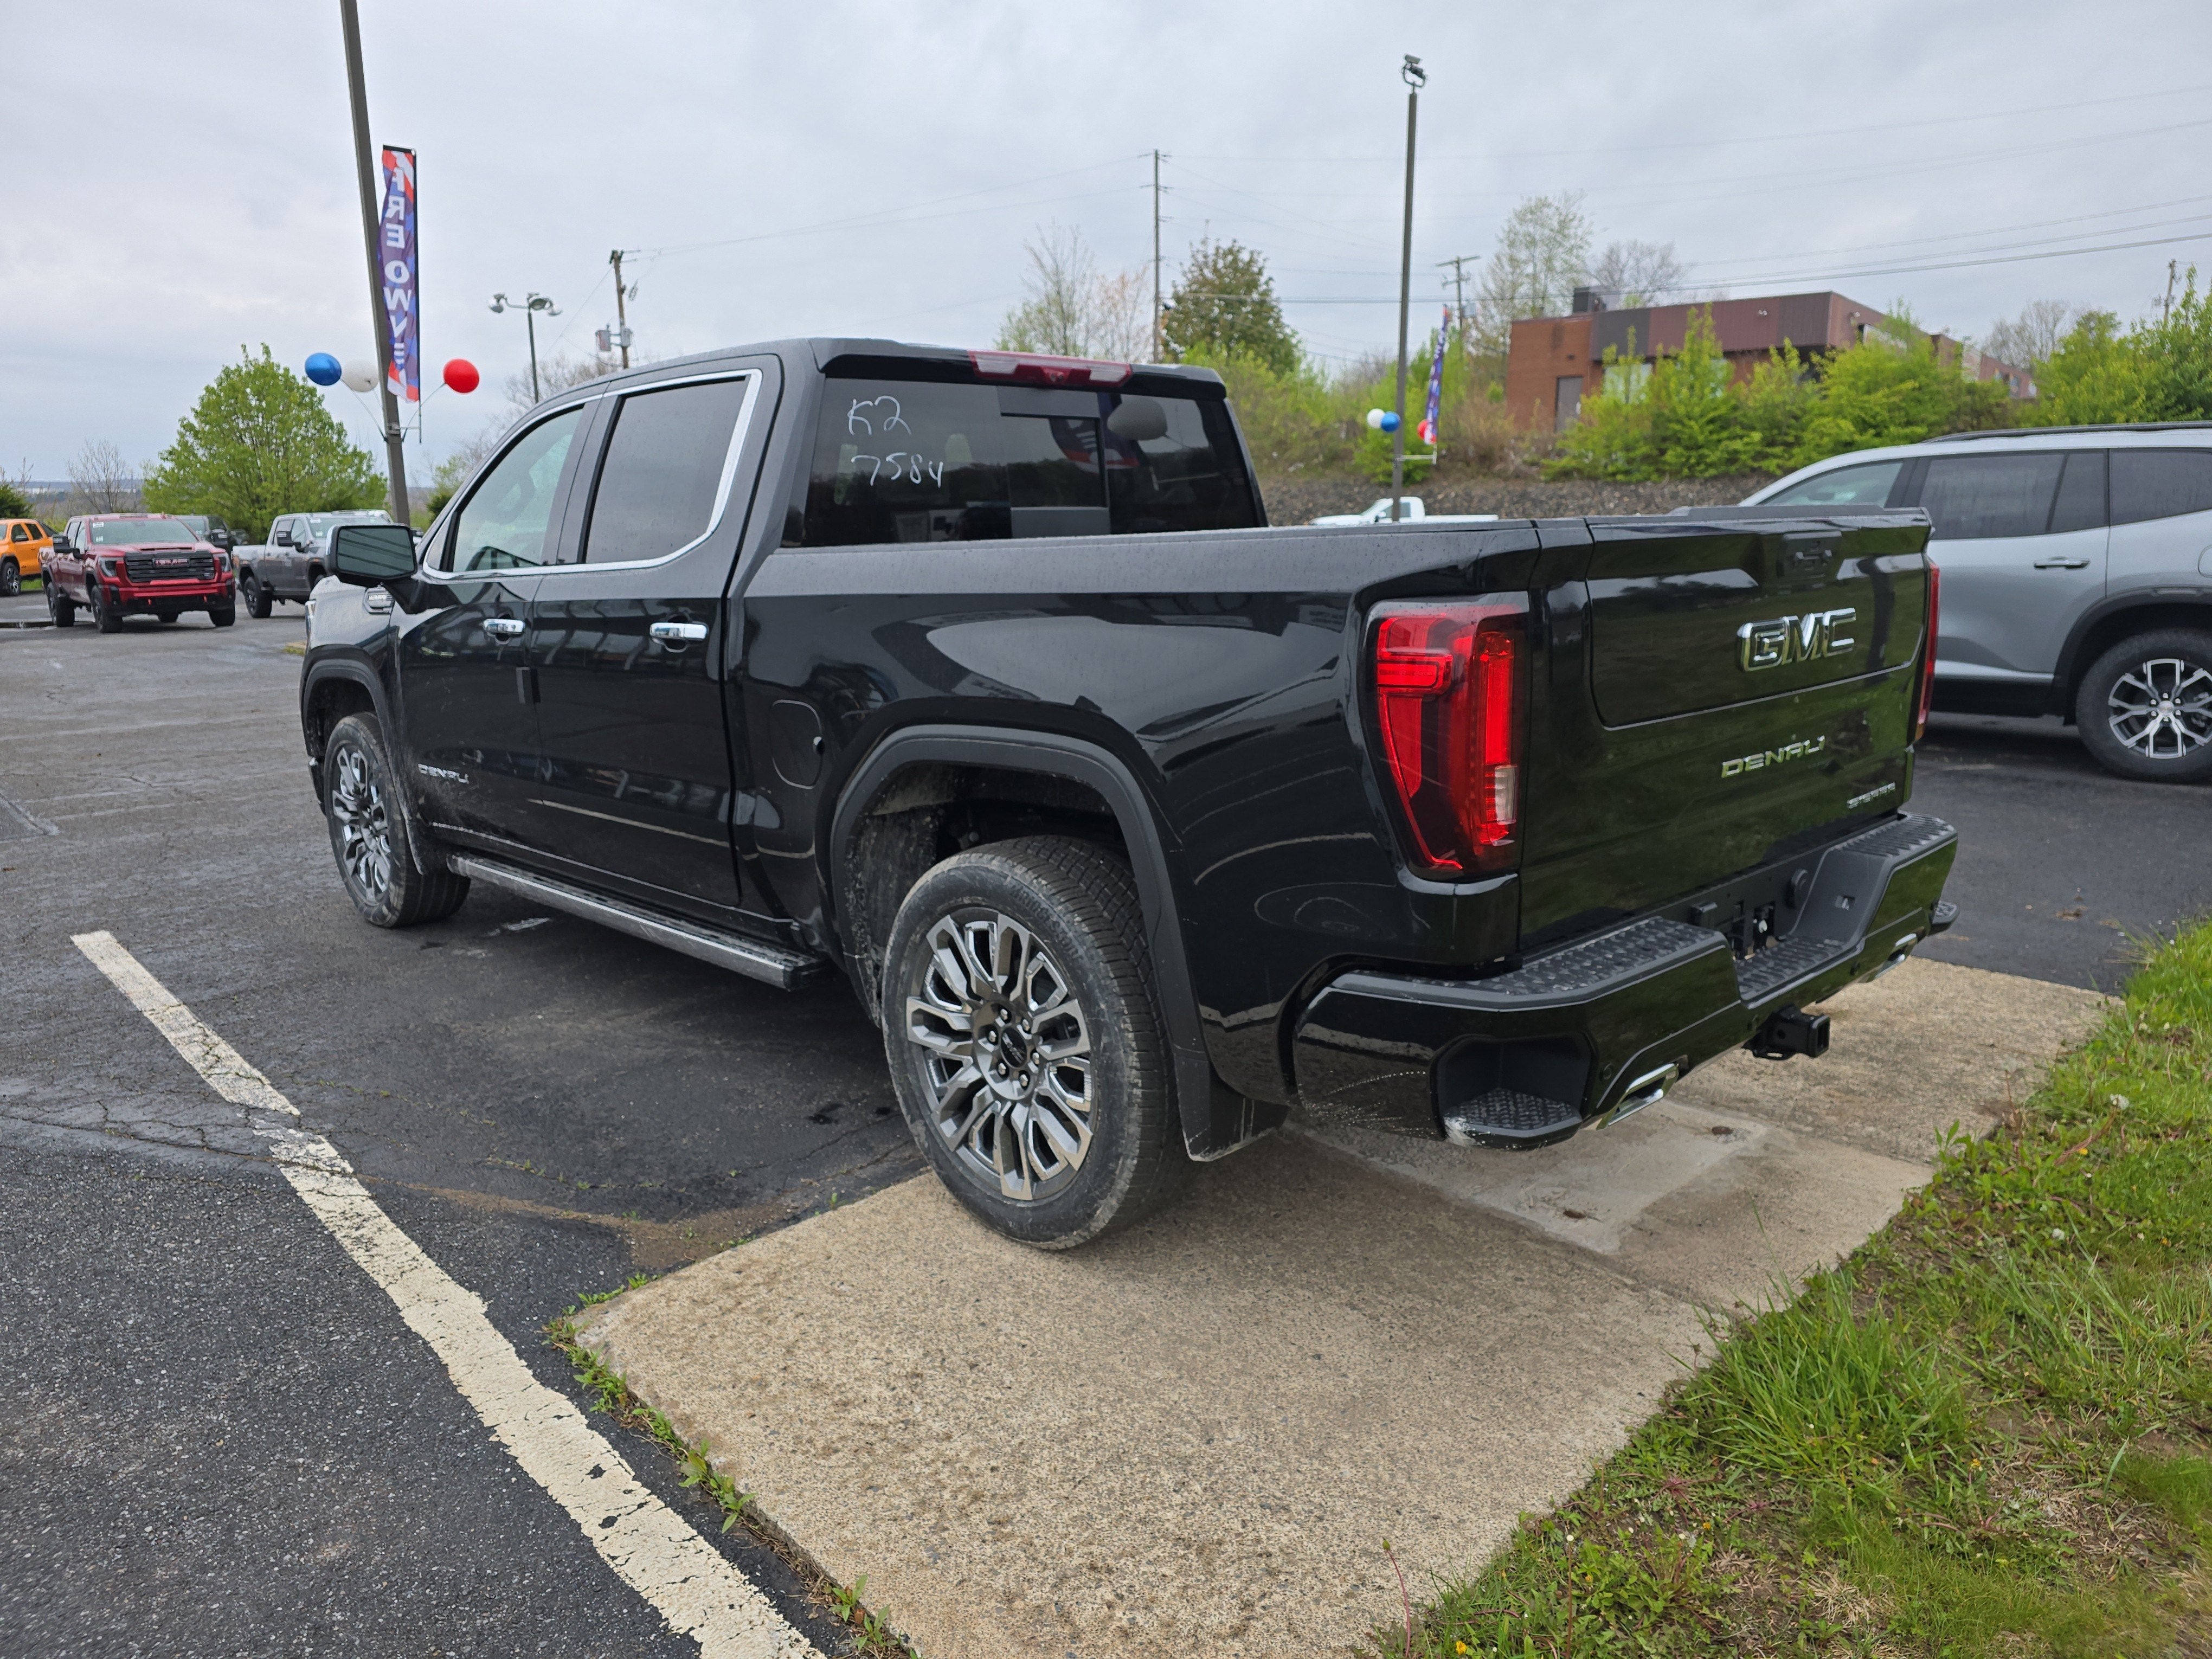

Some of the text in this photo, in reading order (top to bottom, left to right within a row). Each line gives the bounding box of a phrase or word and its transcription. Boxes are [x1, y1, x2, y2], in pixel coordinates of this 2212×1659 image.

[851, 452, 944, 488] 7584
[1737, 607, 1856, 672] GMC
[417, 763, 470, 785] DENALI
[1721, 735, 1825, 779] DENALI
[1847, 782, 1895, 809] SIERRA
